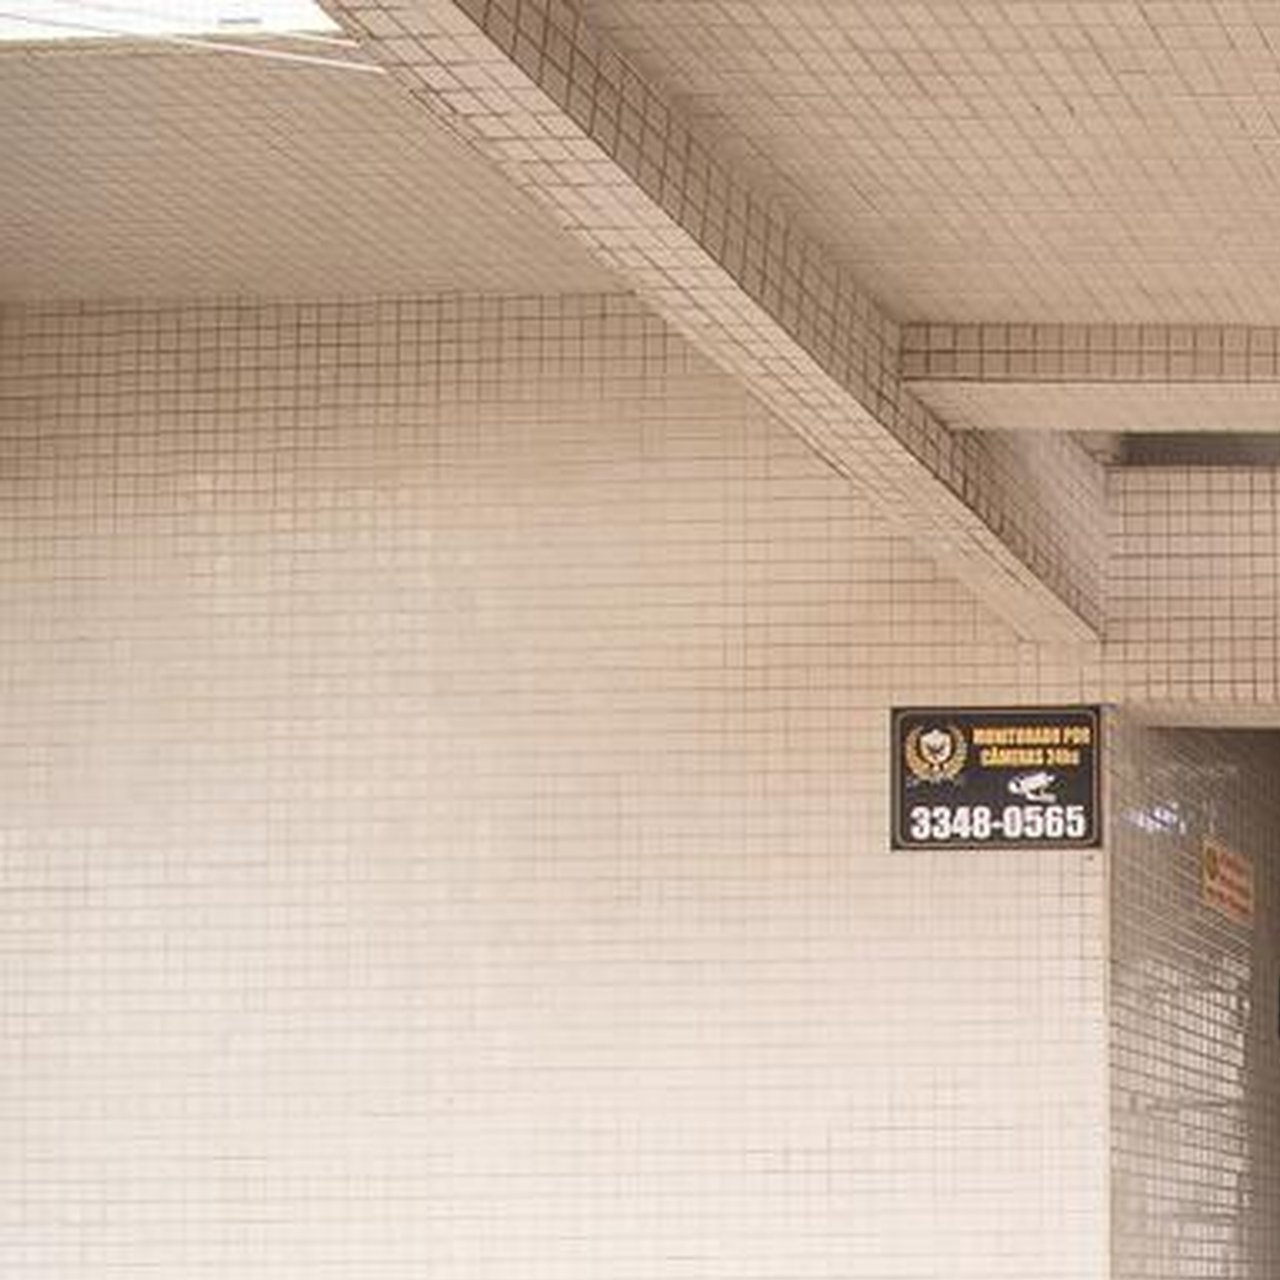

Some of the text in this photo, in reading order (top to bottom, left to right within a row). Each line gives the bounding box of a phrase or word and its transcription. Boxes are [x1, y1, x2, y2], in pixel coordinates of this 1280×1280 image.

[973, 726, 1091, 745] MONITORADO POR
[910, 804, 1086, 839] 3348-0565
